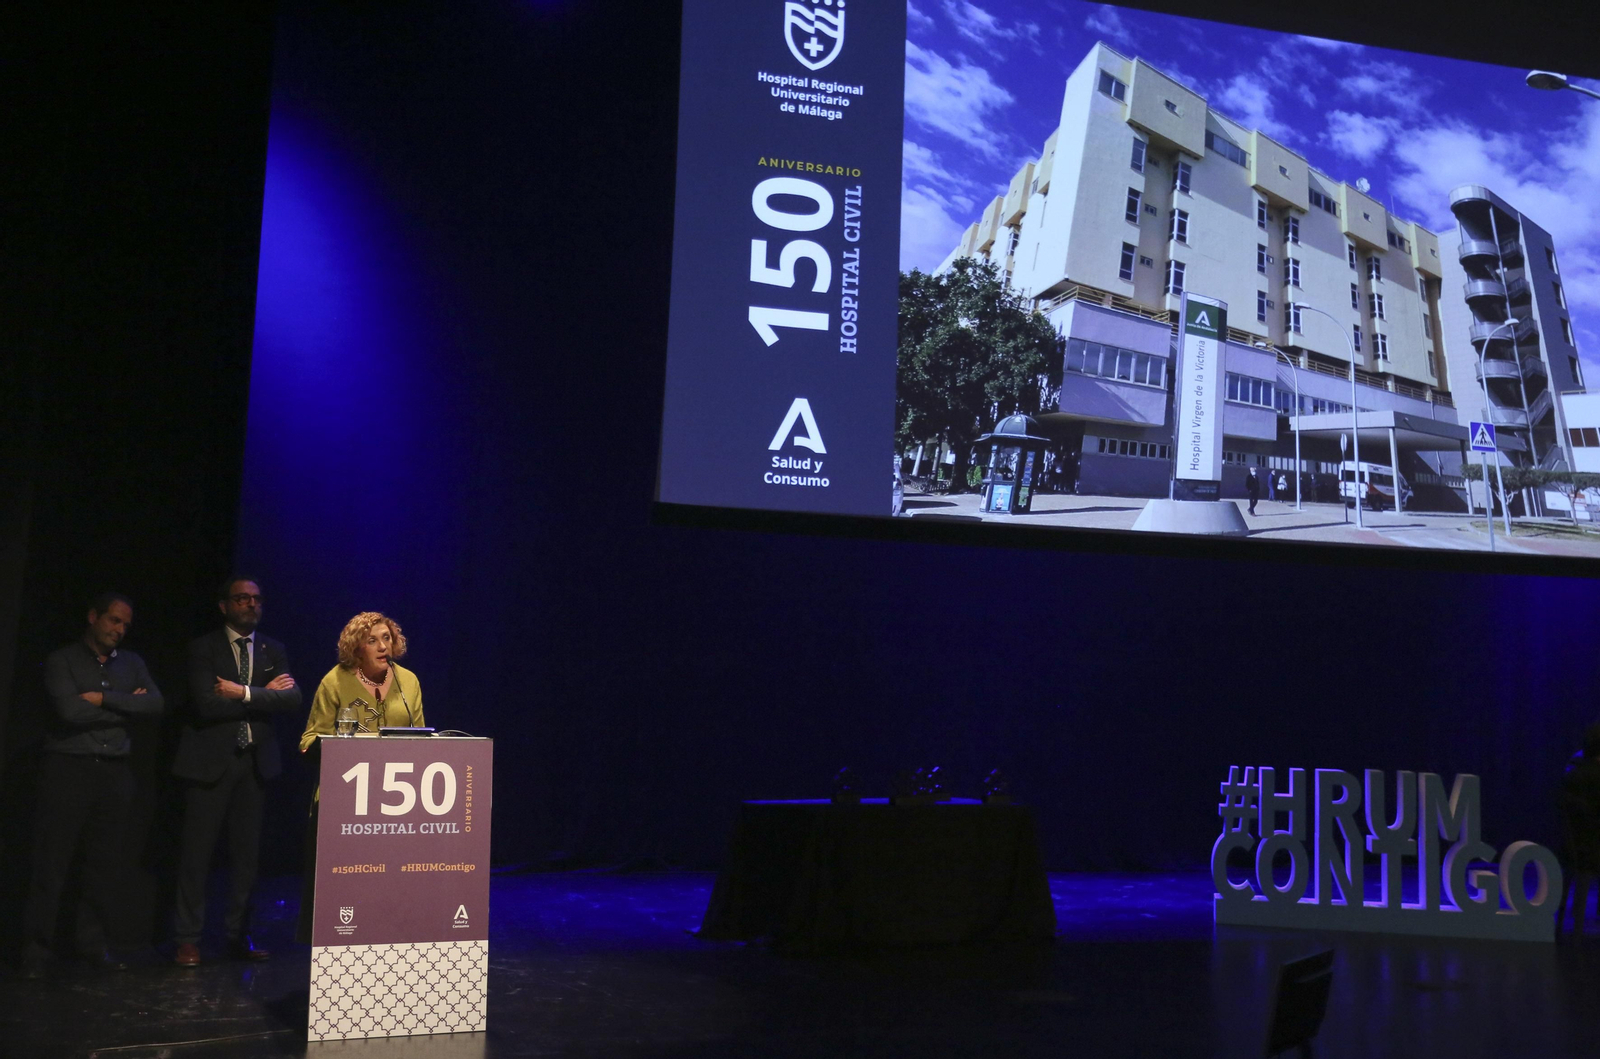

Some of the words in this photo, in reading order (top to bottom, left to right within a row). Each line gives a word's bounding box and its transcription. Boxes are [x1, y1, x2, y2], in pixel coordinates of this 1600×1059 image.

[757, 71, 808, 88] Hospital
[811, 79, 864, 96] Regional
[770, 86, 850, 107] Universitario
[779, 101, 796, 113] de
[798, 104, 843, 121] Málaga
[757, 156, 862, 178] ANIVERSARIO
[843, 185, 862, 243] CIVIL
[748, 176, 834, 347] 150
[839, 247, 860, 354] HOSPITAL
[1194, 340, 1206, 371] Victoria
[1194, 374, 1204, 383] la
[1194, 385, 1204, 397] de
[1191, 399, 1205, 428] Virgen
[771, 456, 811, 470] Salud
[814, 460, 823, 473] y
[1189, 431, 1203, 471] Hospital
[763, 472, 830, 487] Consumo
[341, 761, 457, 816] 150
[464, 765, 473, 833] ANIVERSARIO
[1218, 765, 1482, 842] #HRUM
[340, 823, 416, 835] HOSPITAL
[419, 822, 460, 834] CIVIL
[332, 864, 386, 874] #150HCivil
[401, 862, 476, 873] #HRUMContigo
[1211, 830, 1564, 916] CONTIGO
